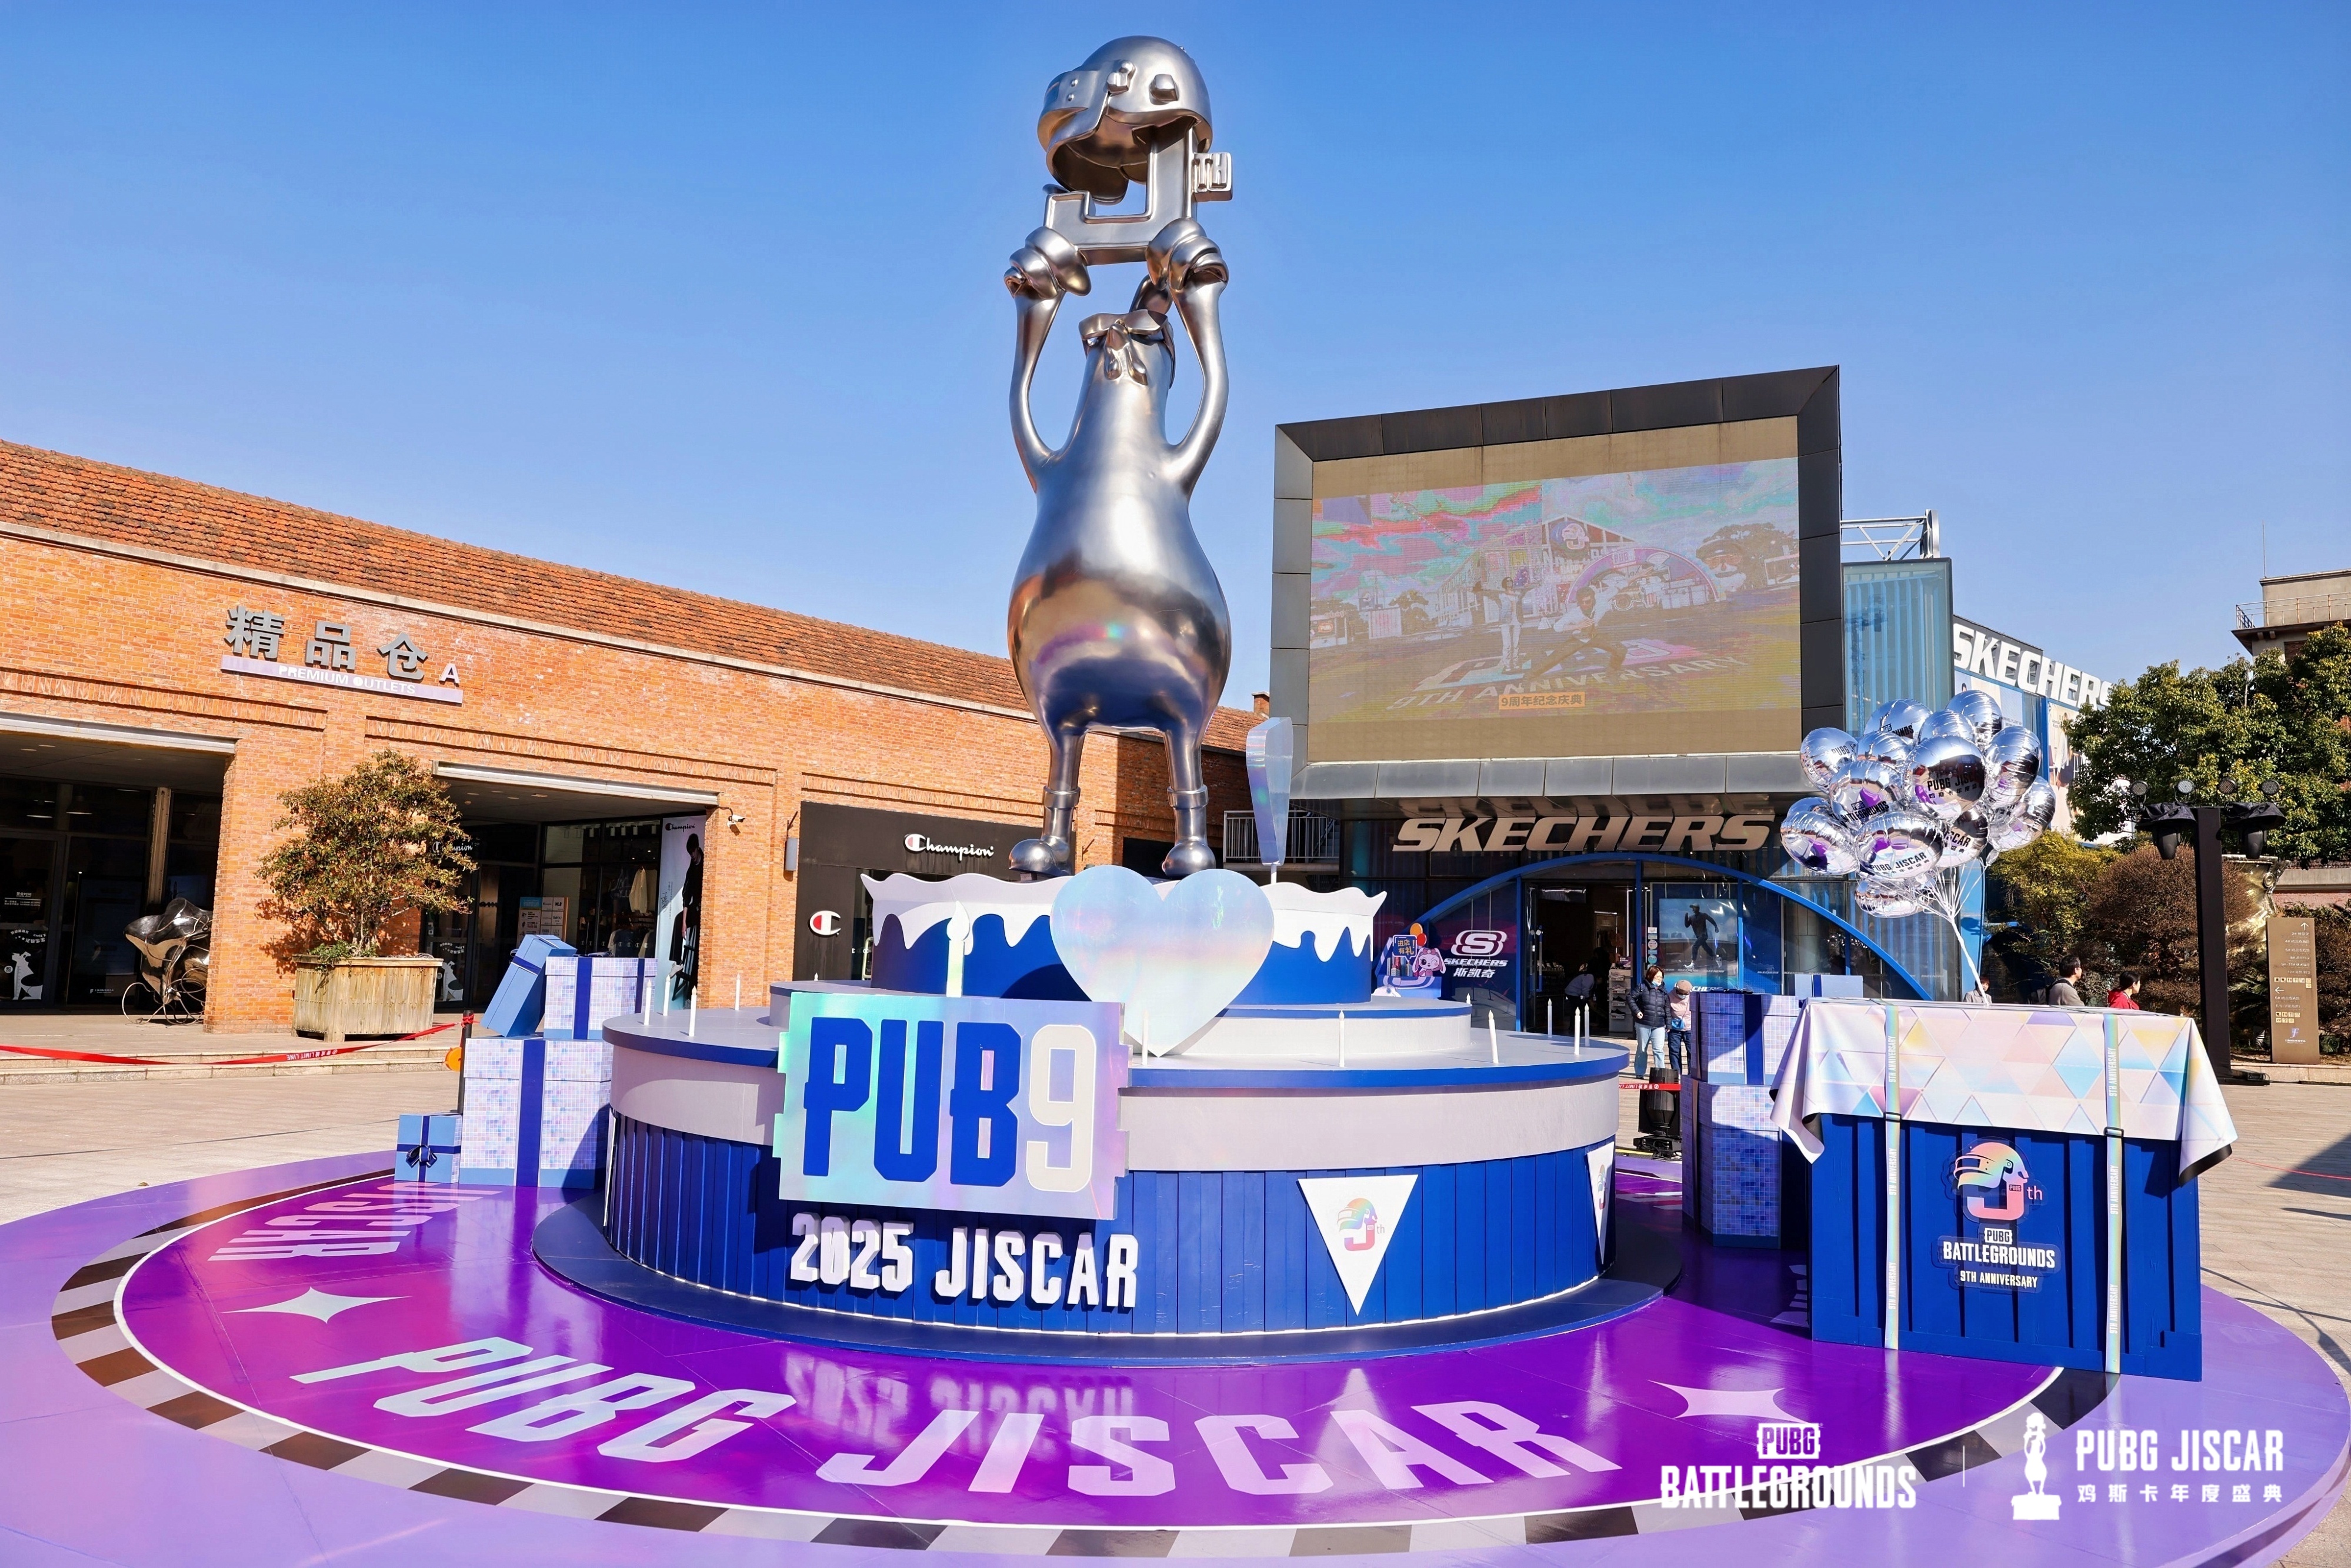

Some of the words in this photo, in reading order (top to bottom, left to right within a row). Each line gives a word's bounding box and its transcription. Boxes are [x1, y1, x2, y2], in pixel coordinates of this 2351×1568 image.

[224, 606, 428, 680] 精品仓
[439, 663, 460, 684] A
[279, 665, 349, 685] PREMIUM
[353, 677, 415, 694] OUTLETS
[1501, 693, 1583, 708] 9周年纪念庆典
[1928, 778, 1951, 791] PUBG
[665, 823, 695, 832] Champion
[1392, 815, 1775, 852] SKECHERS
[905, 833, 994, 861] Champion
[1896, 852, 1927, 869] JISCAR
[1444, 958, 1509, 967] SKECHERS
[1453, 968, 1496, 979] 斯凯奇
[1888, 1036, 1897, 1071] ANNIVERSARY
[2107, 1047, 2117, 1085] ANNIVERSARY
[802, 1016, 1096, 1193] PUB9
[1889, 1148, 1897, 1183] ANNIVERSARY
[2110, 1165, 2119, 1202] ANNIVERSARY
[1986, 1229, 2010, 1243] PUBG
[790, 1212, 914, 1292] 2025
[935, 1226, 1138, 1308] JISCAR
[1943, 1241, 2055, 1269] BATTLEGROUNDS
[1888, 1262, 1897, 1297] ANNIVERSARY
[1960, 1270, 1977, 1283] 9TH
[1979, 1272, 2037, 1288] ANNIVERSARY
[2109, 1284, 2119, 1322] ANNIVERSARY
[289, 1337, 797, 1463] PUBG
[815, 1400, 1623, 1496] JISCAR
